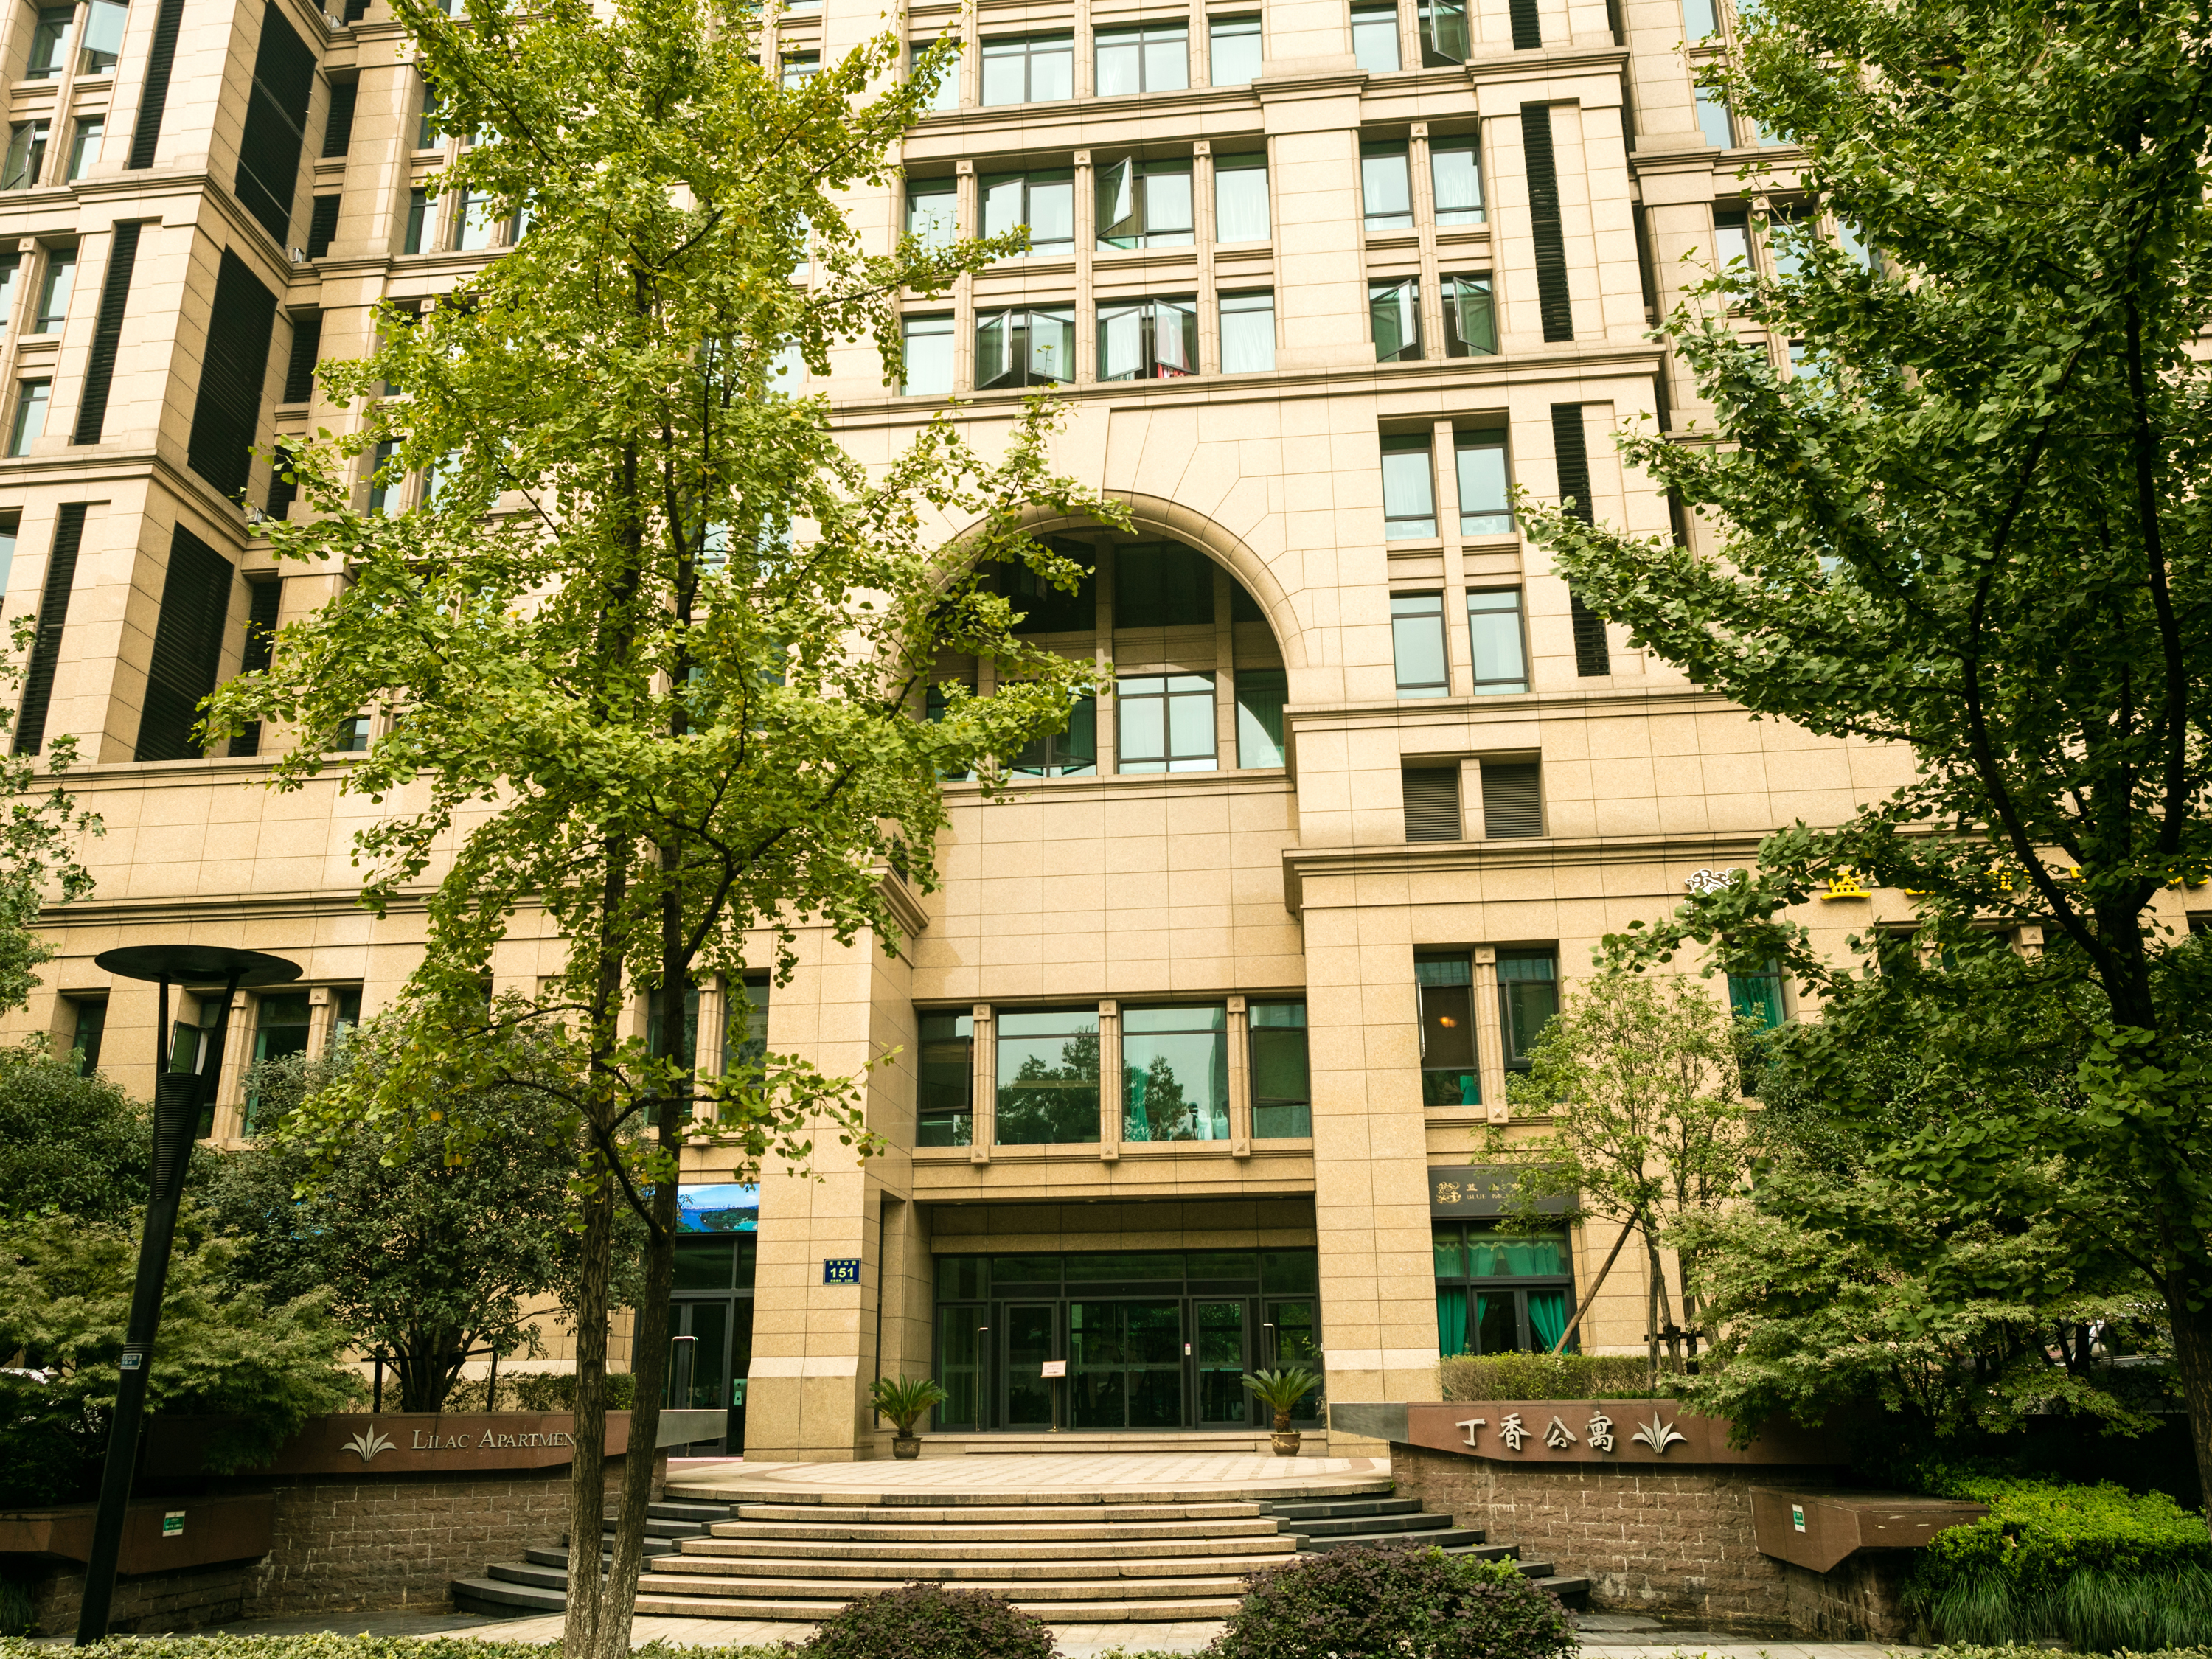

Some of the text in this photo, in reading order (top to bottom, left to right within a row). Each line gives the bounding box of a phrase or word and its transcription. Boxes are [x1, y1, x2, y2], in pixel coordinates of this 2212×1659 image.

[830, 1267, 854, 1278] 151
[477, 1428, 575, 1448] APARTMEN
[1455, 1411, 1615, 1452] 丁香公寓
